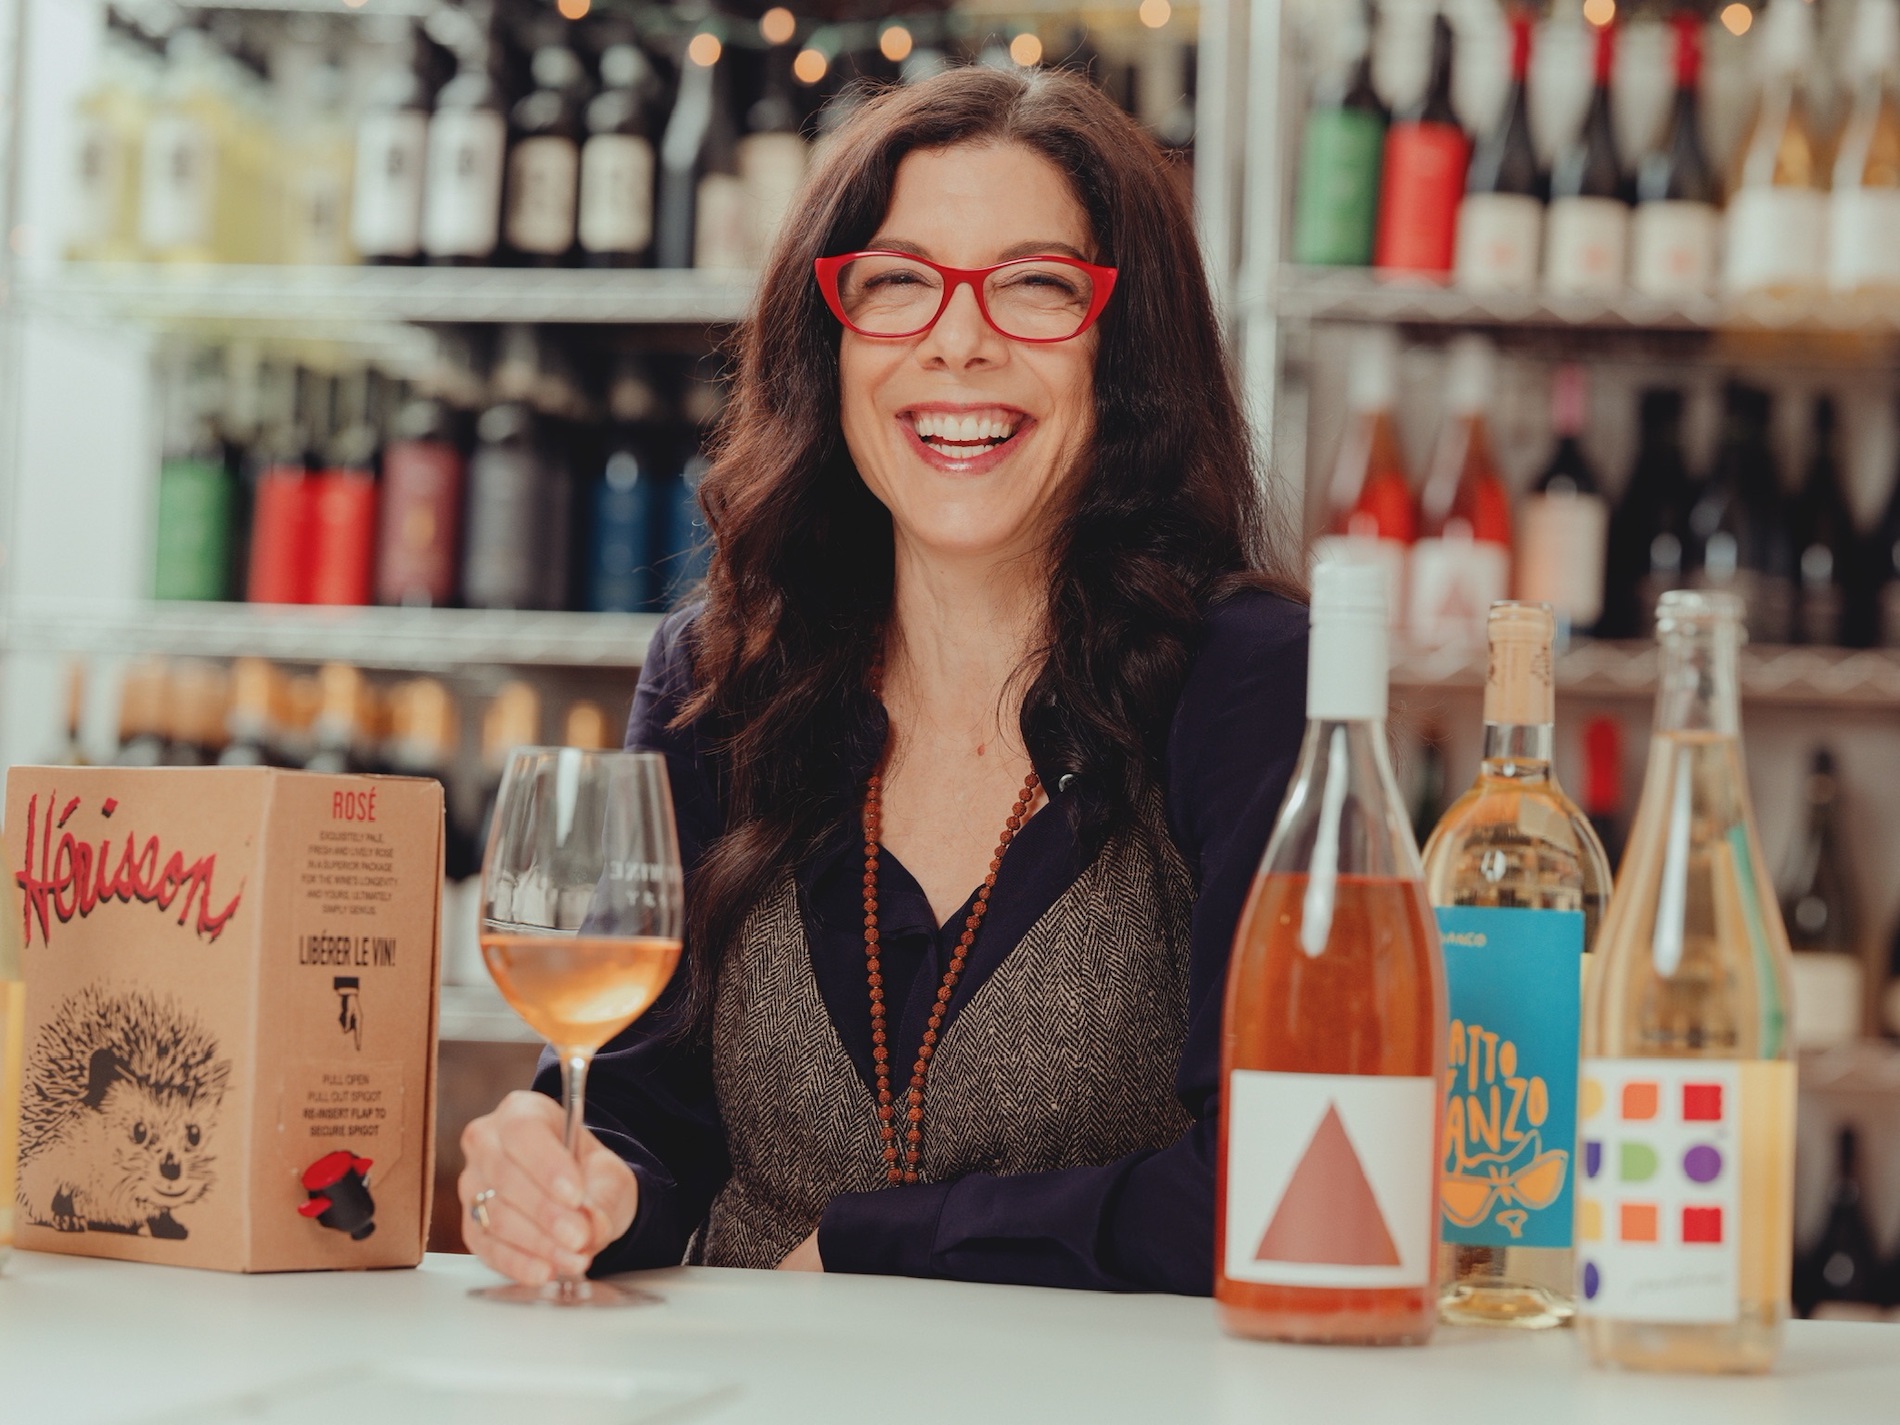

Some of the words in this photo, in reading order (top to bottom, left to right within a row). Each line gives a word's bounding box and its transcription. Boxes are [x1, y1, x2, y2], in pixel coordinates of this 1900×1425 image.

[332, 786, 377, 822] ROSÉ
[15, 789, 246, 949] Hérisson
[299, 928, 351, 966] LIBÉRER
[355, 936, 369, 966] LE
[372, 936, 396, 966] VIN!
[1448, 1019, 1517, 1092] ATTO
[307, 1091, 329, 1102] PULL
[331, 1091, 349, 1102] OUT
[351, 1091, 381, 1102] SPIGOT
[322, 1074, 344, 1085] PULL
[345, 1074, 369, 1085] OPEN
[310, 1125, 345, 1136] SECURE
[347, 1125, 379, 1136] SPIGOT
[351, 1108, 373, 1119] FLAP
[375, 1108, 387, 1119] TO
[1444, 1072, 1549, 1155] ANZO
